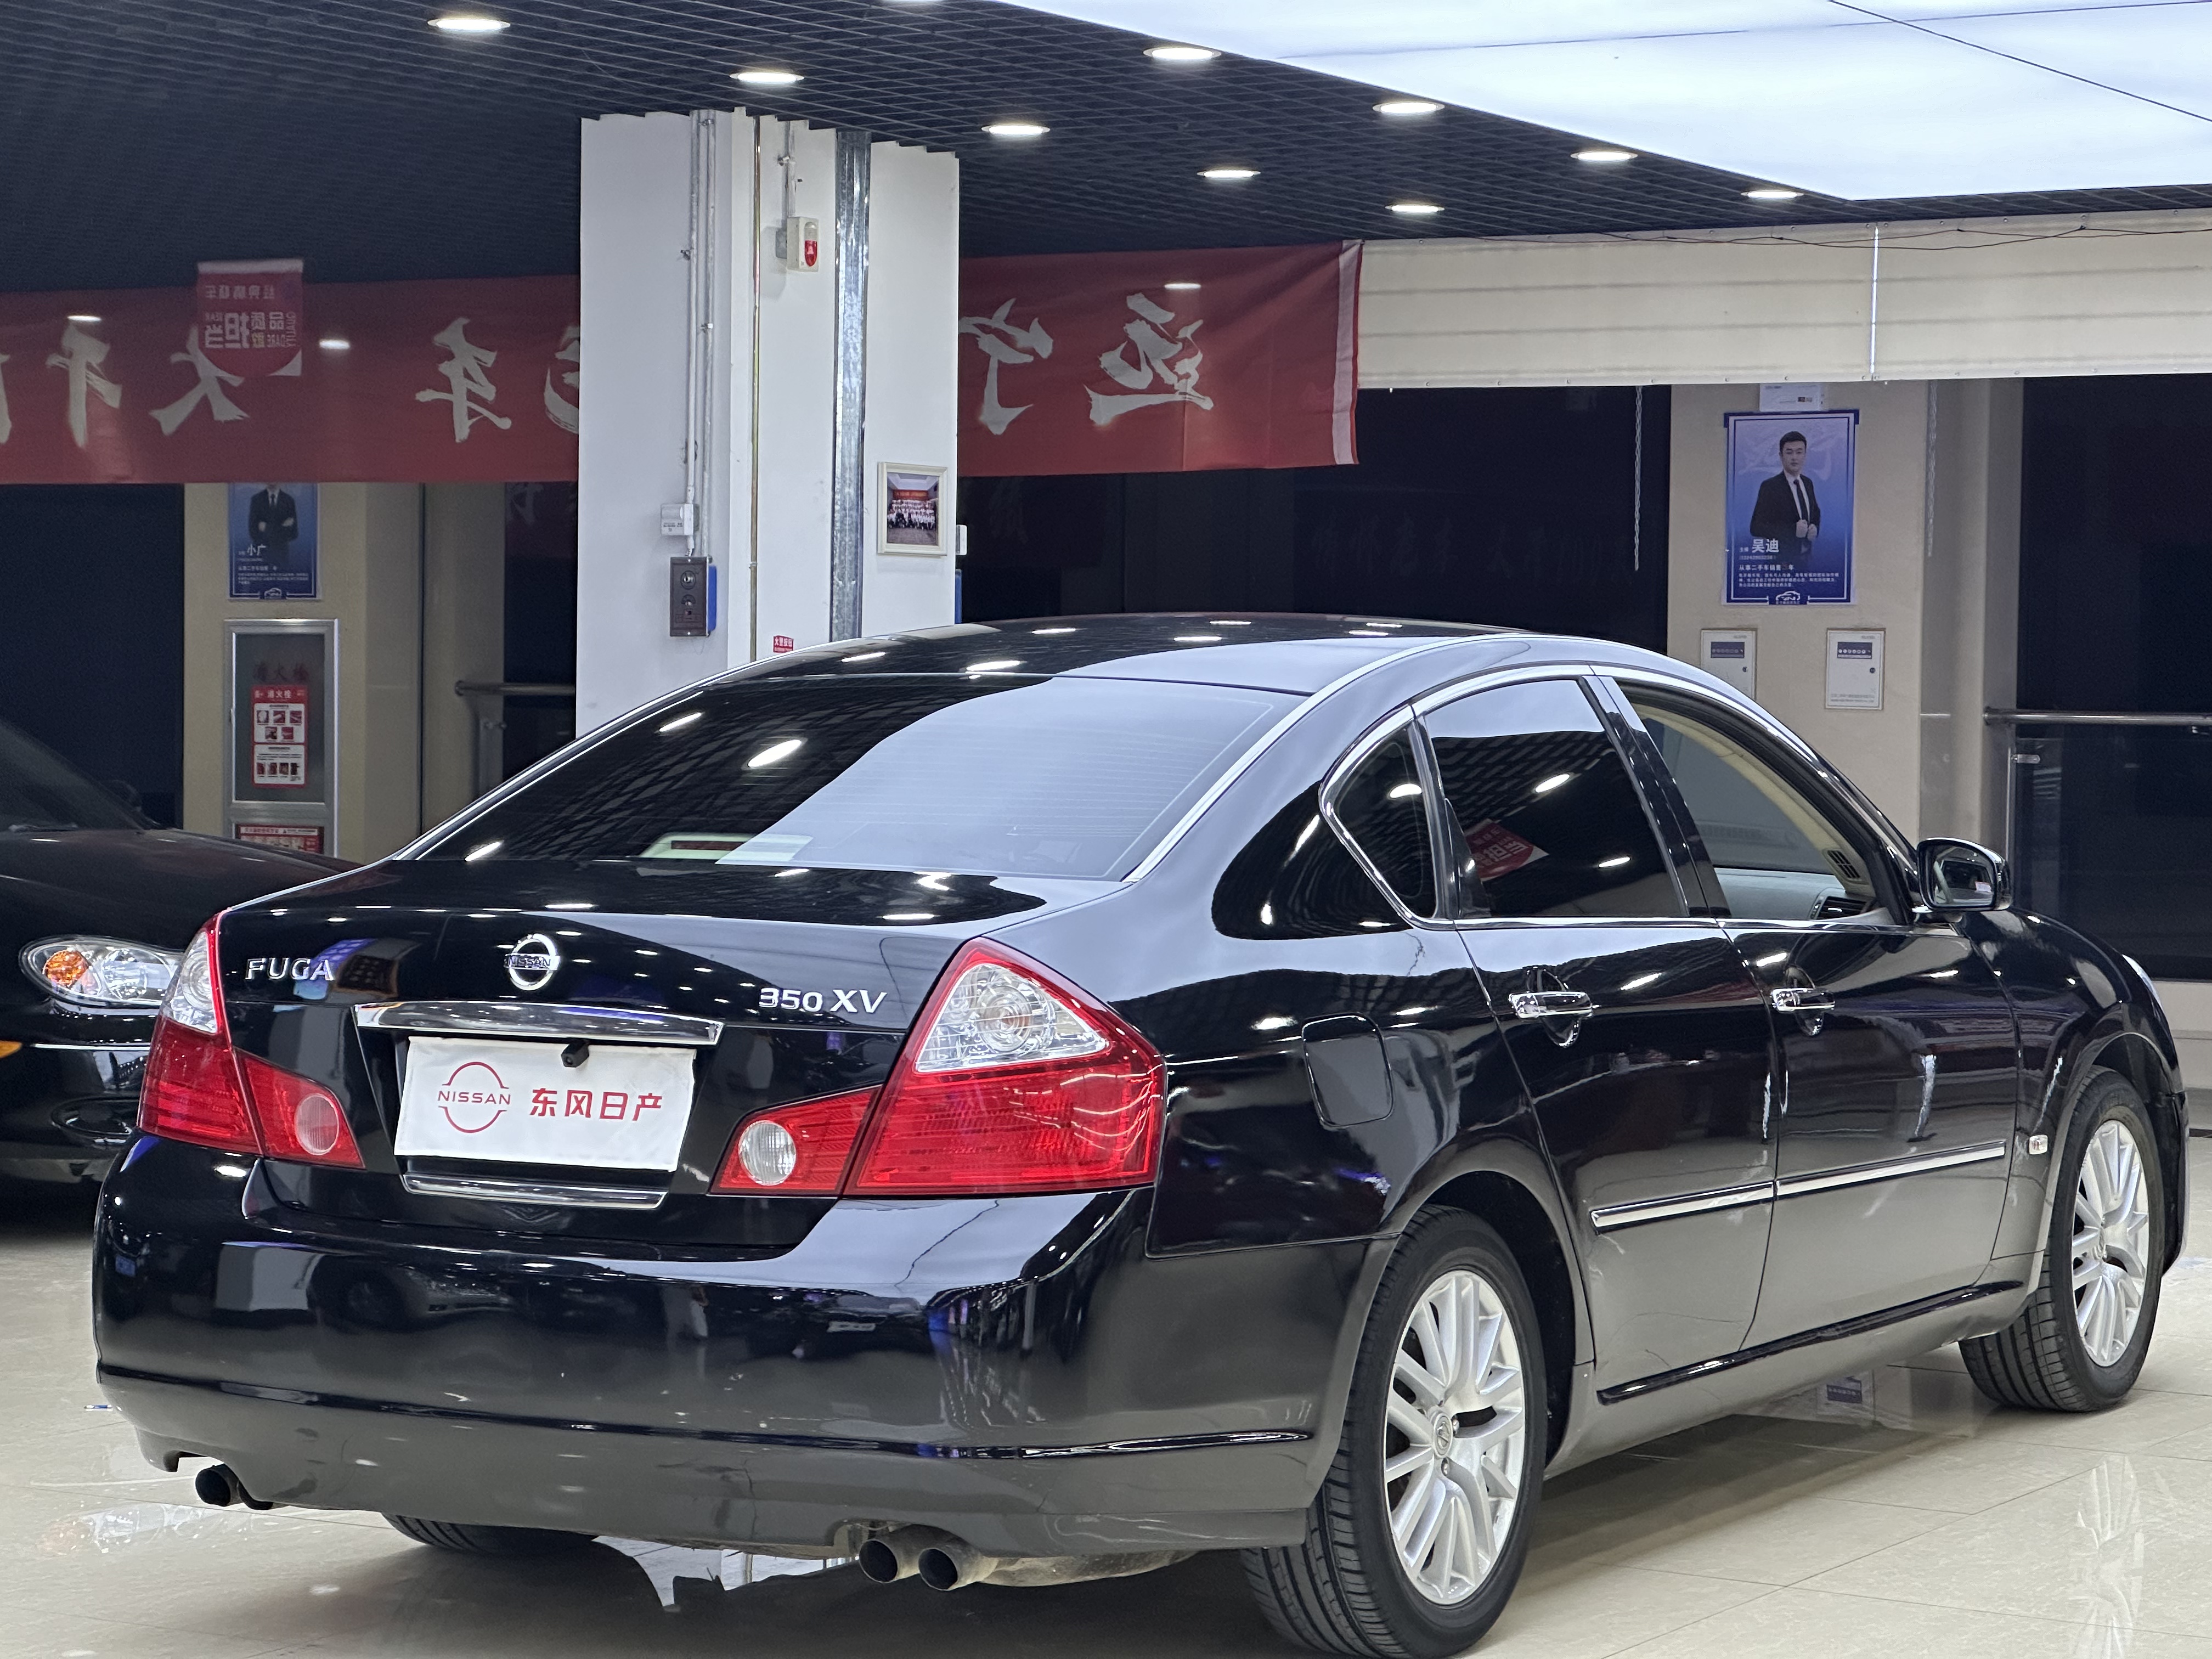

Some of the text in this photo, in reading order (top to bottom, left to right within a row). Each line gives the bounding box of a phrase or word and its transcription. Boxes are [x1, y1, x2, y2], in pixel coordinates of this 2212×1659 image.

[1751, 538, 1779, 553] 吴迪
[245, 957, 335, 981] FUGA
[508, 955, 551, 968] NISSAN
[759, 988, 887, 1013] 350 XV
[437, 1090, 511, 1105] NISSAN
[529, 1088, 663, 1121] 东风日产
